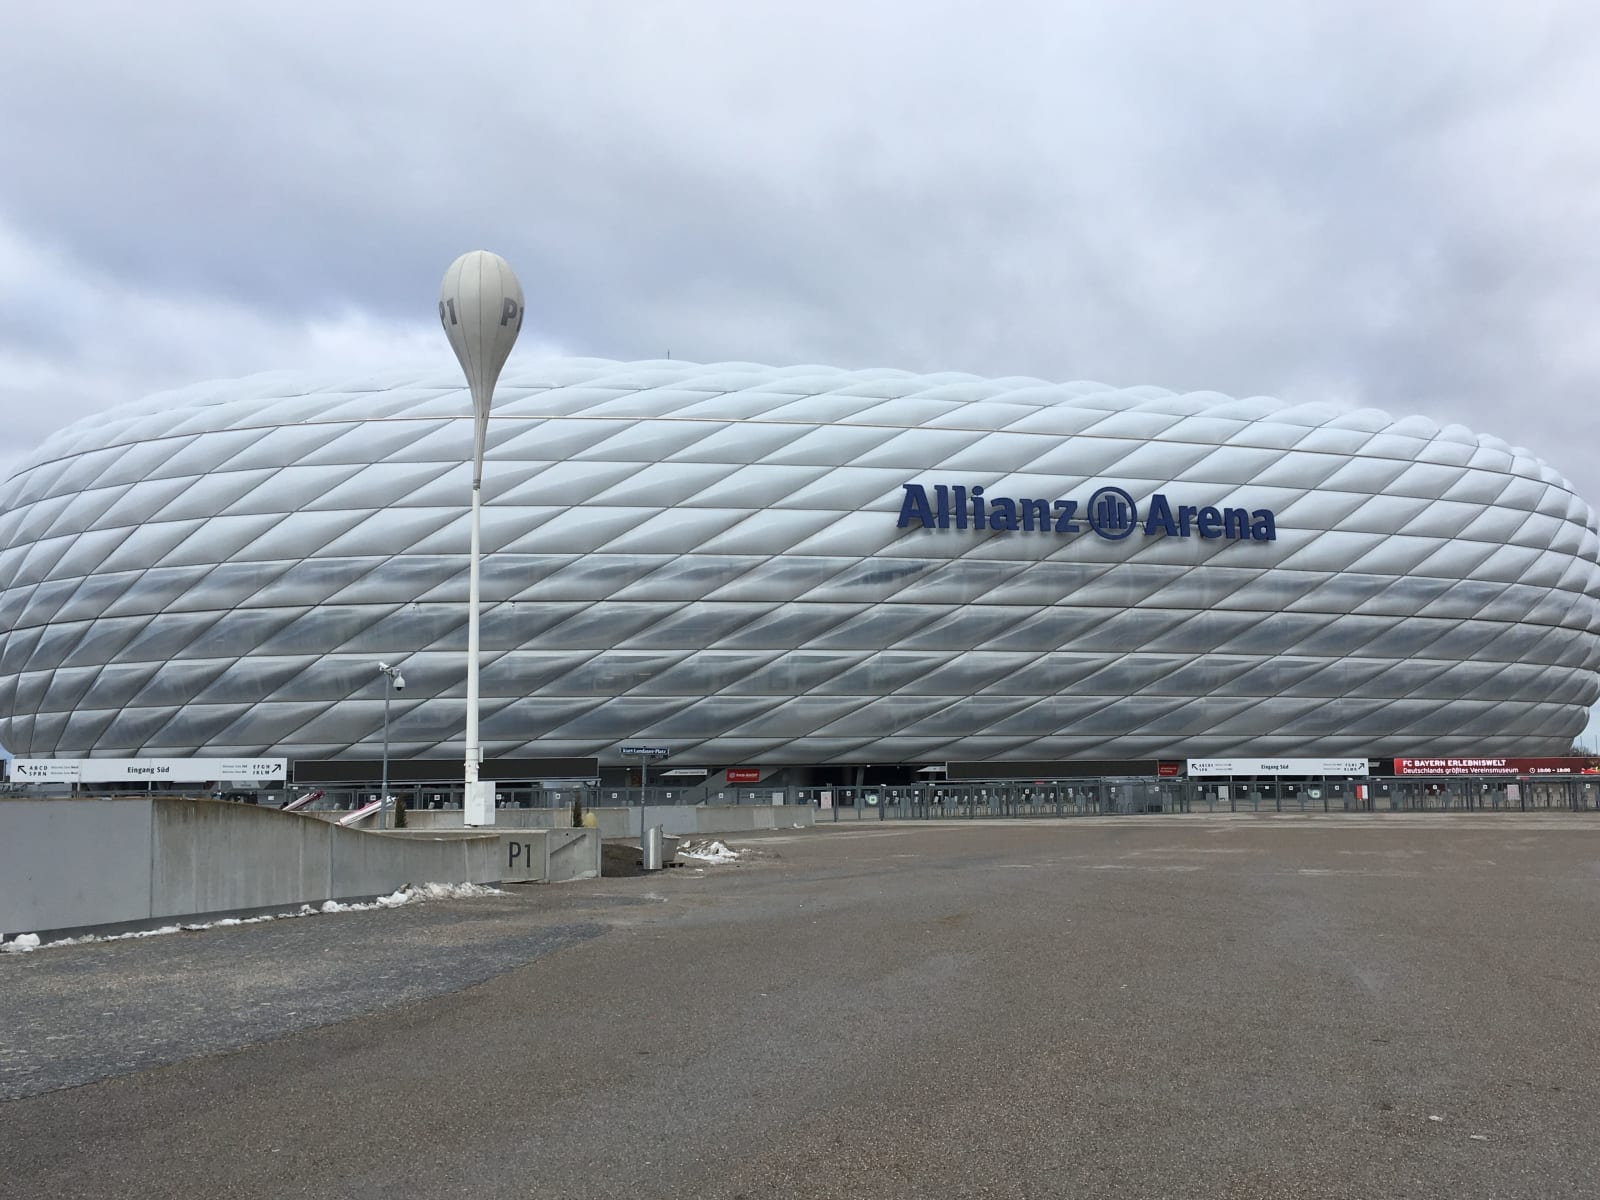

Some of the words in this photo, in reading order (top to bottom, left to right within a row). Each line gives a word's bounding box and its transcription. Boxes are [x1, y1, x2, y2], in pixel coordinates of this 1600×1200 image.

[897, 484, 1080, 533] Allianz
[1144, 494, 1277, 540] Arena
[127, 766, 155, 774] Eingang
[156, 765, 170, 773] Süd
[508, 841, 531, 868] P1
